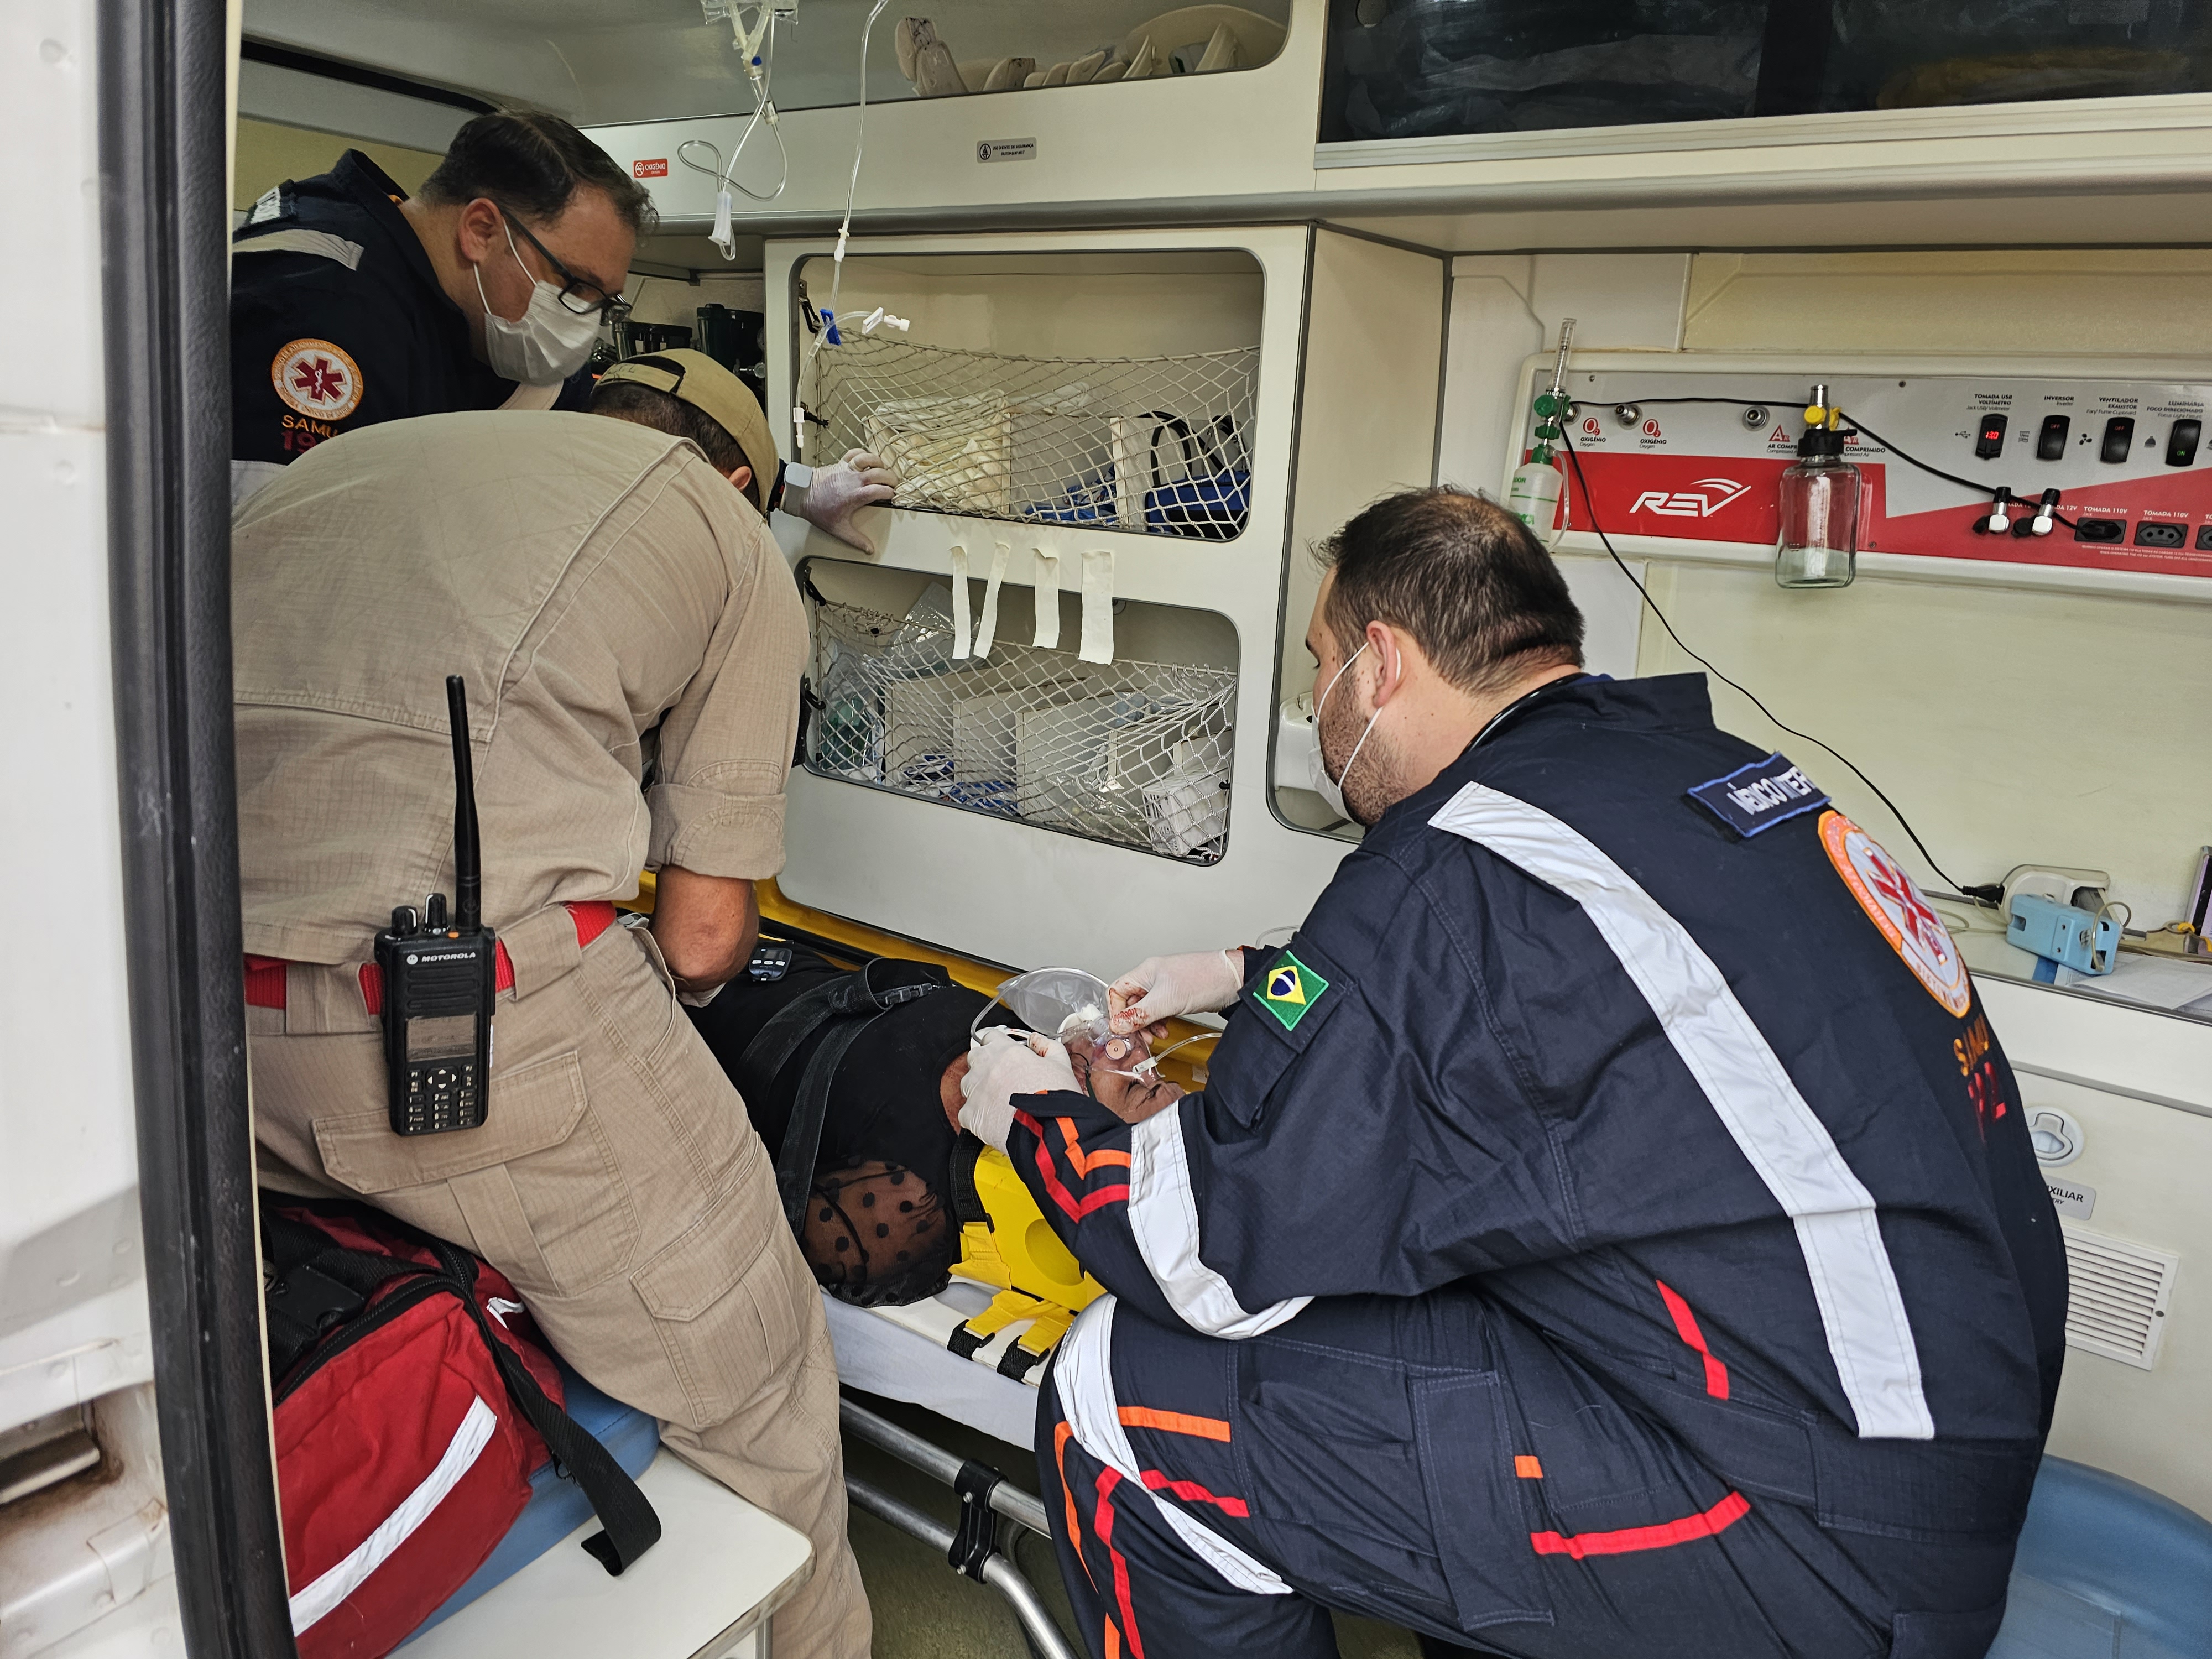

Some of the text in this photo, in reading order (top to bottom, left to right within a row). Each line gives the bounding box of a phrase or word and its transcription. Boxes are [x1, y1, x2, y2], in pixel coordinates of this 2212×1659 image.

[645, 162, 666, 170] OXIGÊNIO
[281, 415, 340, 439] SAMU
[281, 430, 324, 453] 19
[1629, 486, 1751, 517] REV
[421, 952, 476, 962] MOTOROLA
[2047, 1185, 2084, 1203] XILIAR
